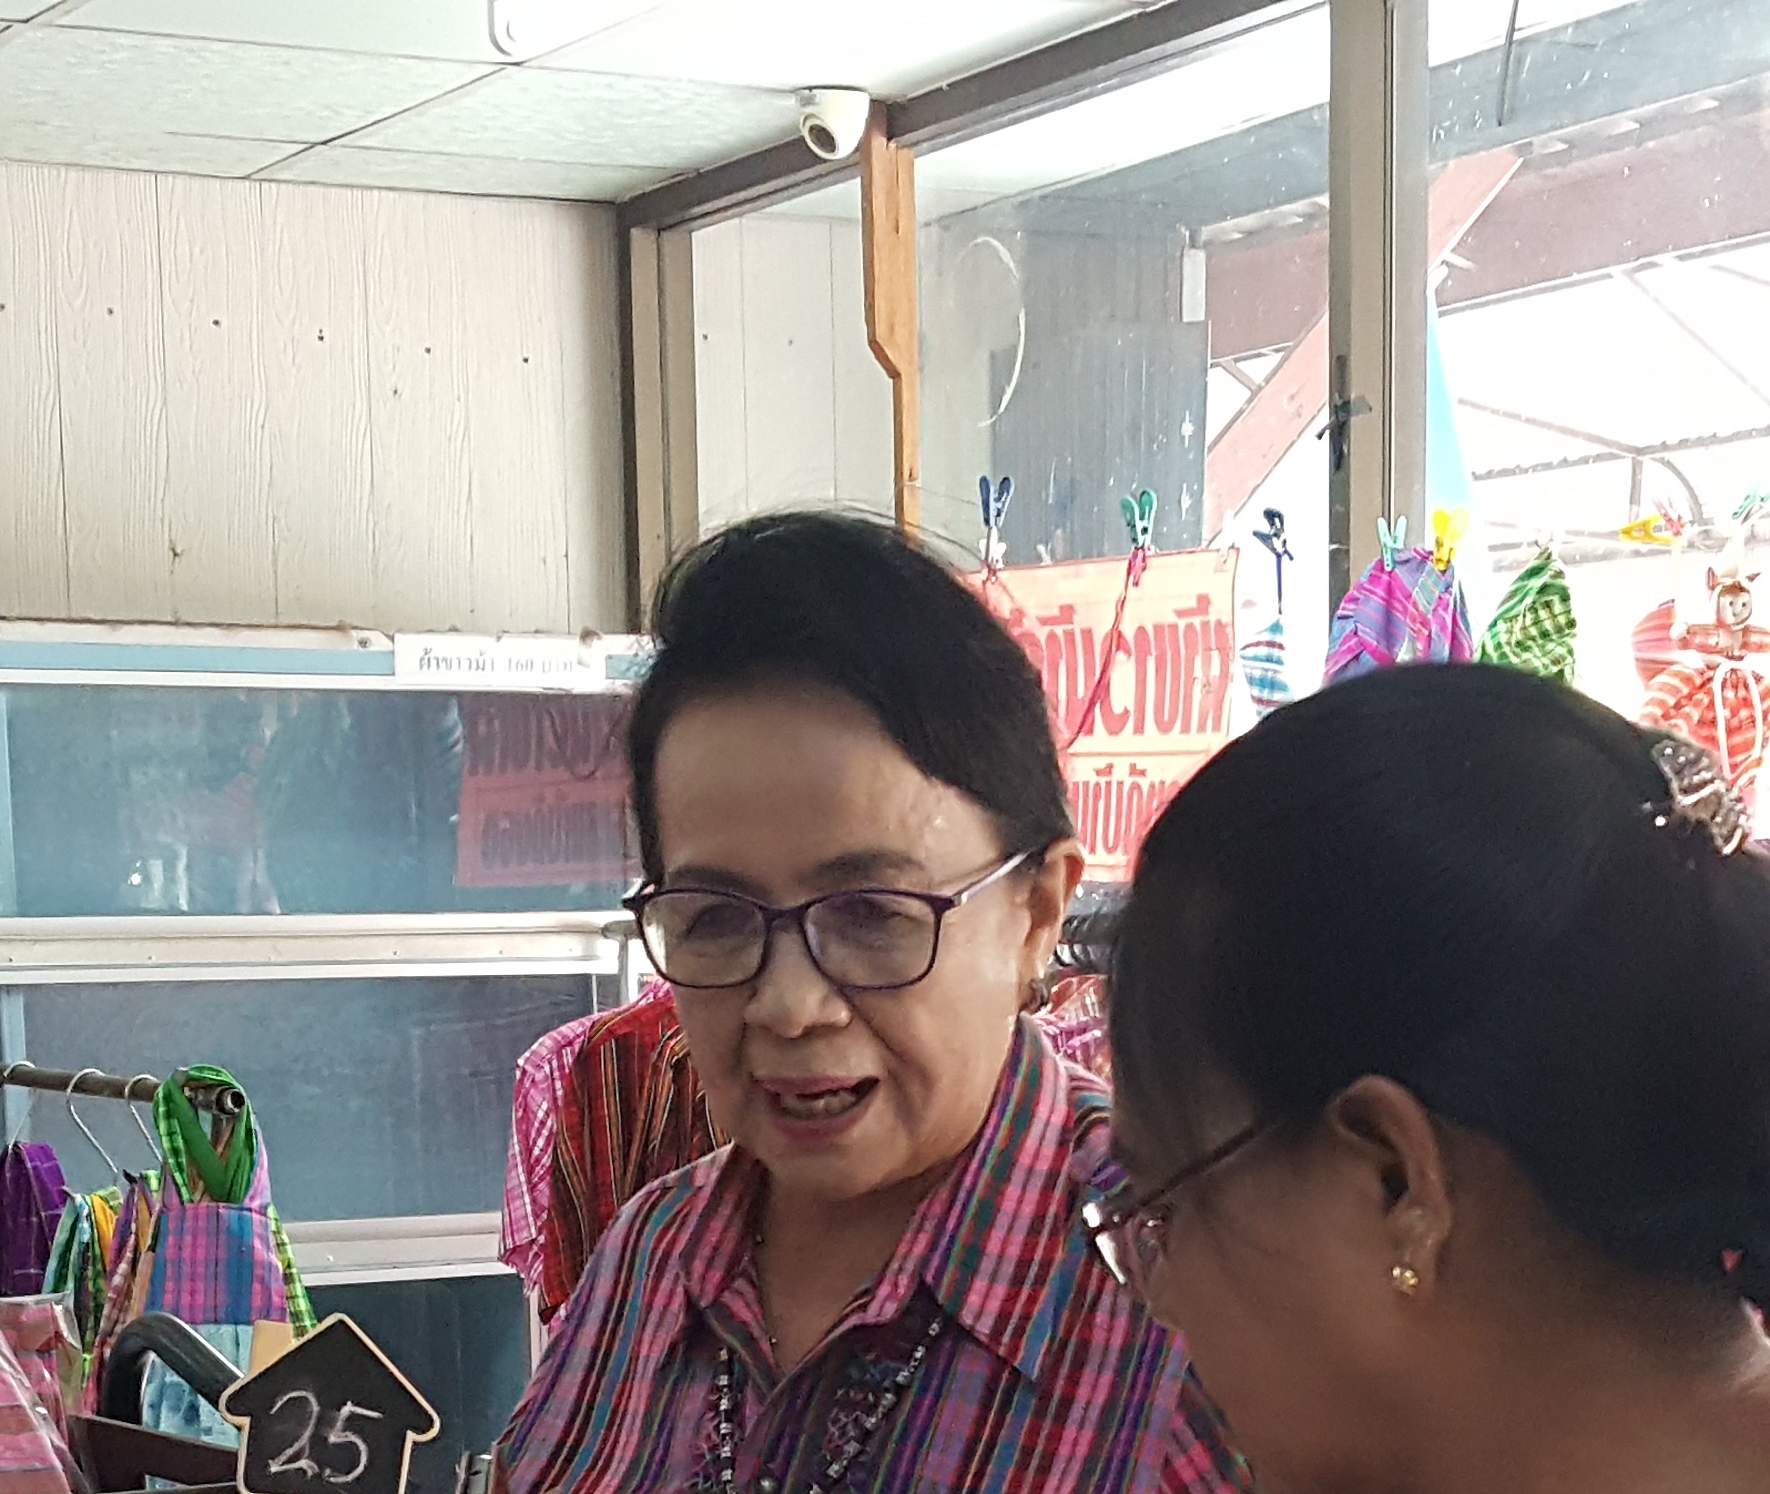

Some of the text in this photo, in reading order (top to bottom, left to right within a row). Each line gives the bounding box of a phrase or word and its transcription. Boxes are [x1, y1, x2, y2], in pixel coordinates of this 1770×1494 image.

[418, 646, 495, 673] ผ้าขาวม้า
[507, 656, 534, 673] 160
[265, 1388, 385, 1484] 25
